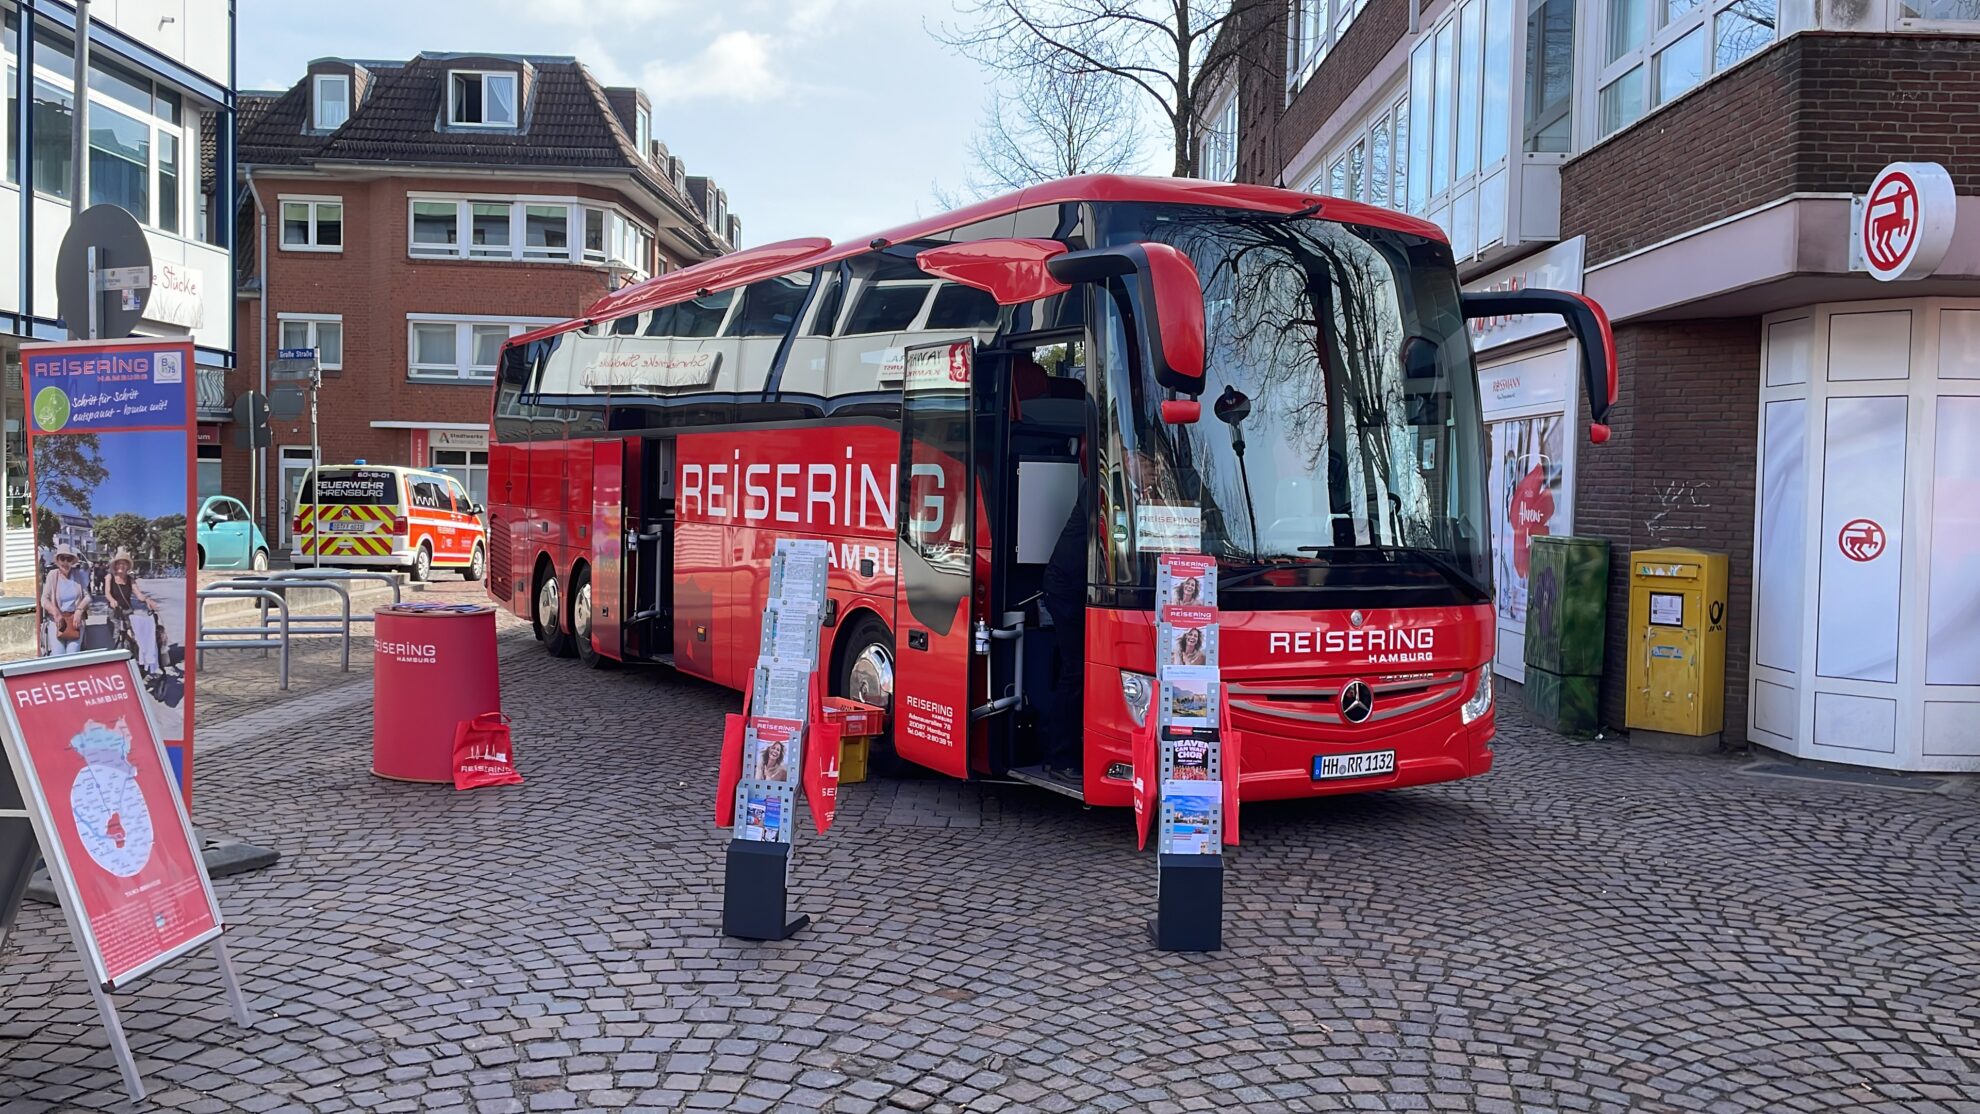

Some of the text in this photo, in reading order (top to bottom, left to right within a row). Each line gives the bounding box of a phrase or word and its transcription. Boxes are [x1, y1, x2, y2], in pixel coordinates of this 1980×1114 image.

[161, 266, 197, 295] Stücke
[316, 481, 385, 490] FEUERWEHR
[316, 489, 384, 497] AHRENSBURG
[1369, 652, 1433, 664] HAMBURG
[84, 692, 129, 707] HAMBURG
[907, 695, 953, 717] REISERING
[1178, 751, 1203, 760] CHOR
[1322, 758, 1339, 775] HH
[1347, 756, 1363, 773] RR
[1365, 753, 1393, 771] 1132
